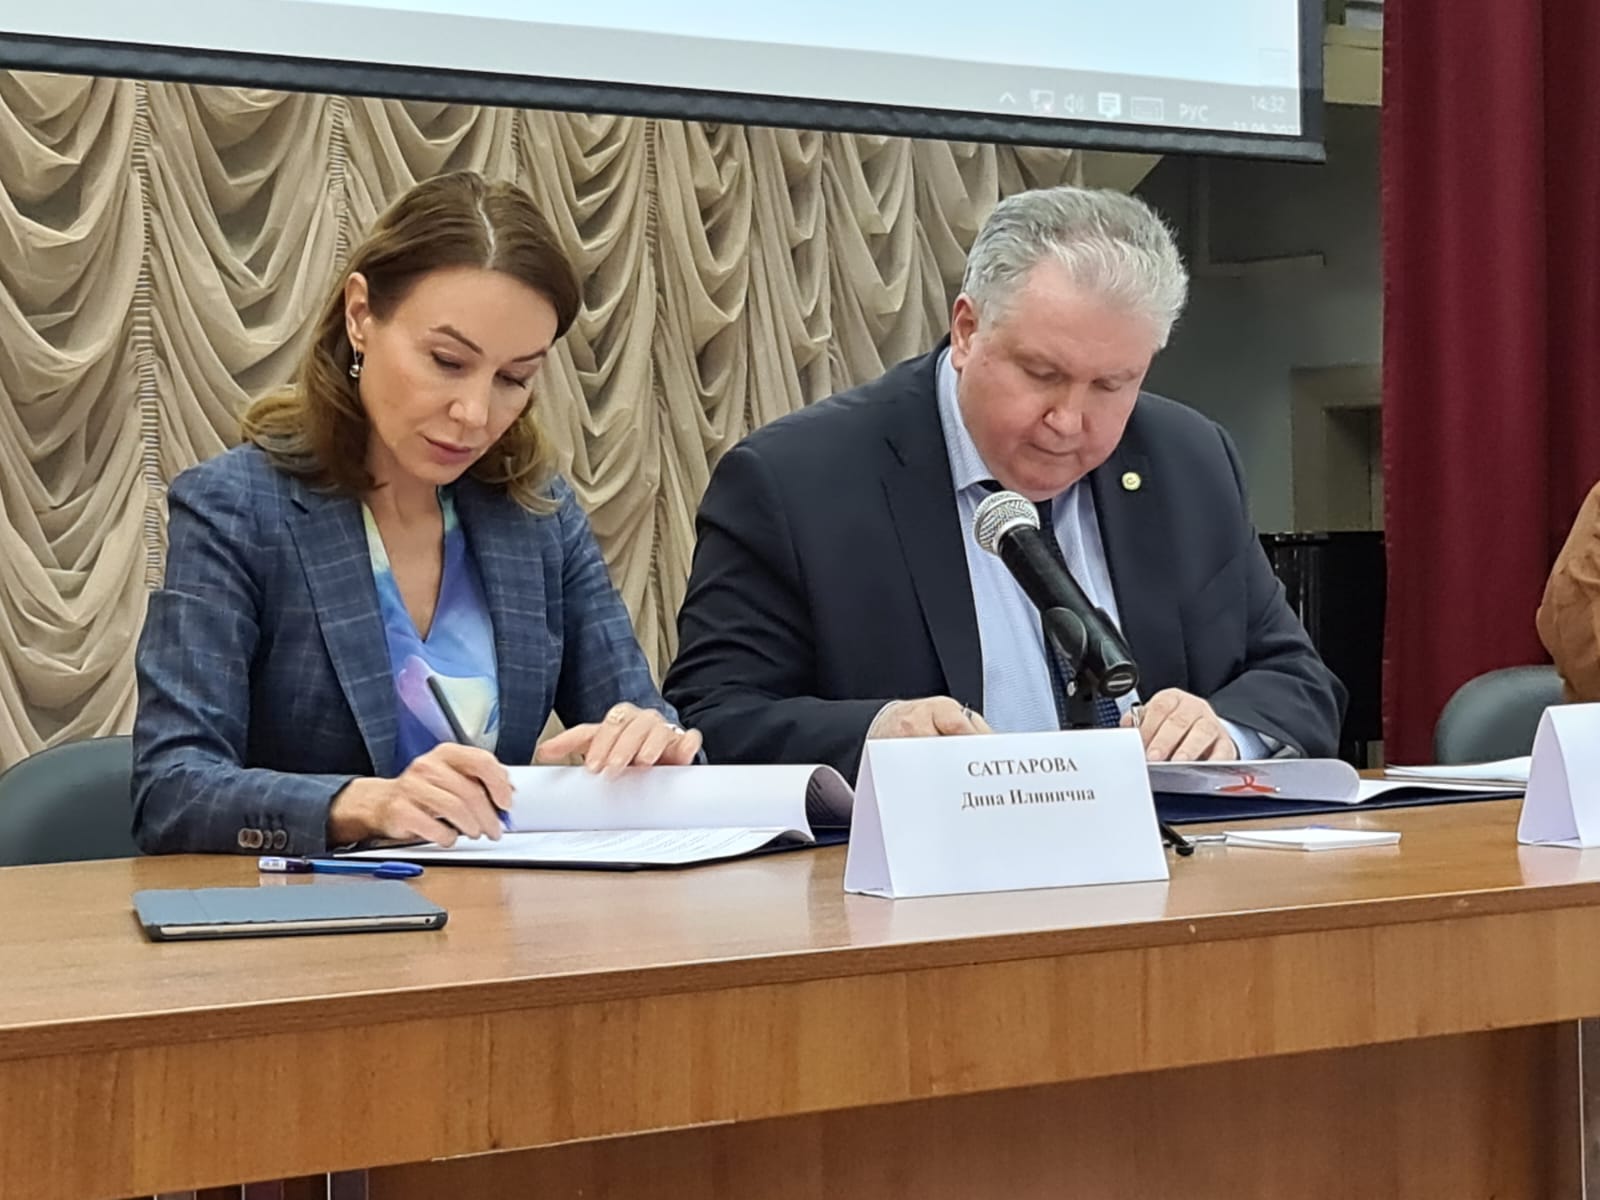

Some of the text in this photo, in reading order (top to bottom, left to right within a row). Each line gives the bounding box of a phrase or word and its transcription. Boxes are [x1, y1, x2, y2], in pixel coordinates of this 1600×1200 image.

[1179, 102, 1209, 122] РУС
[967, 757, 1078, 776] САТТАРОВА
[961, 789, 1095, 810] Дина Илинична
